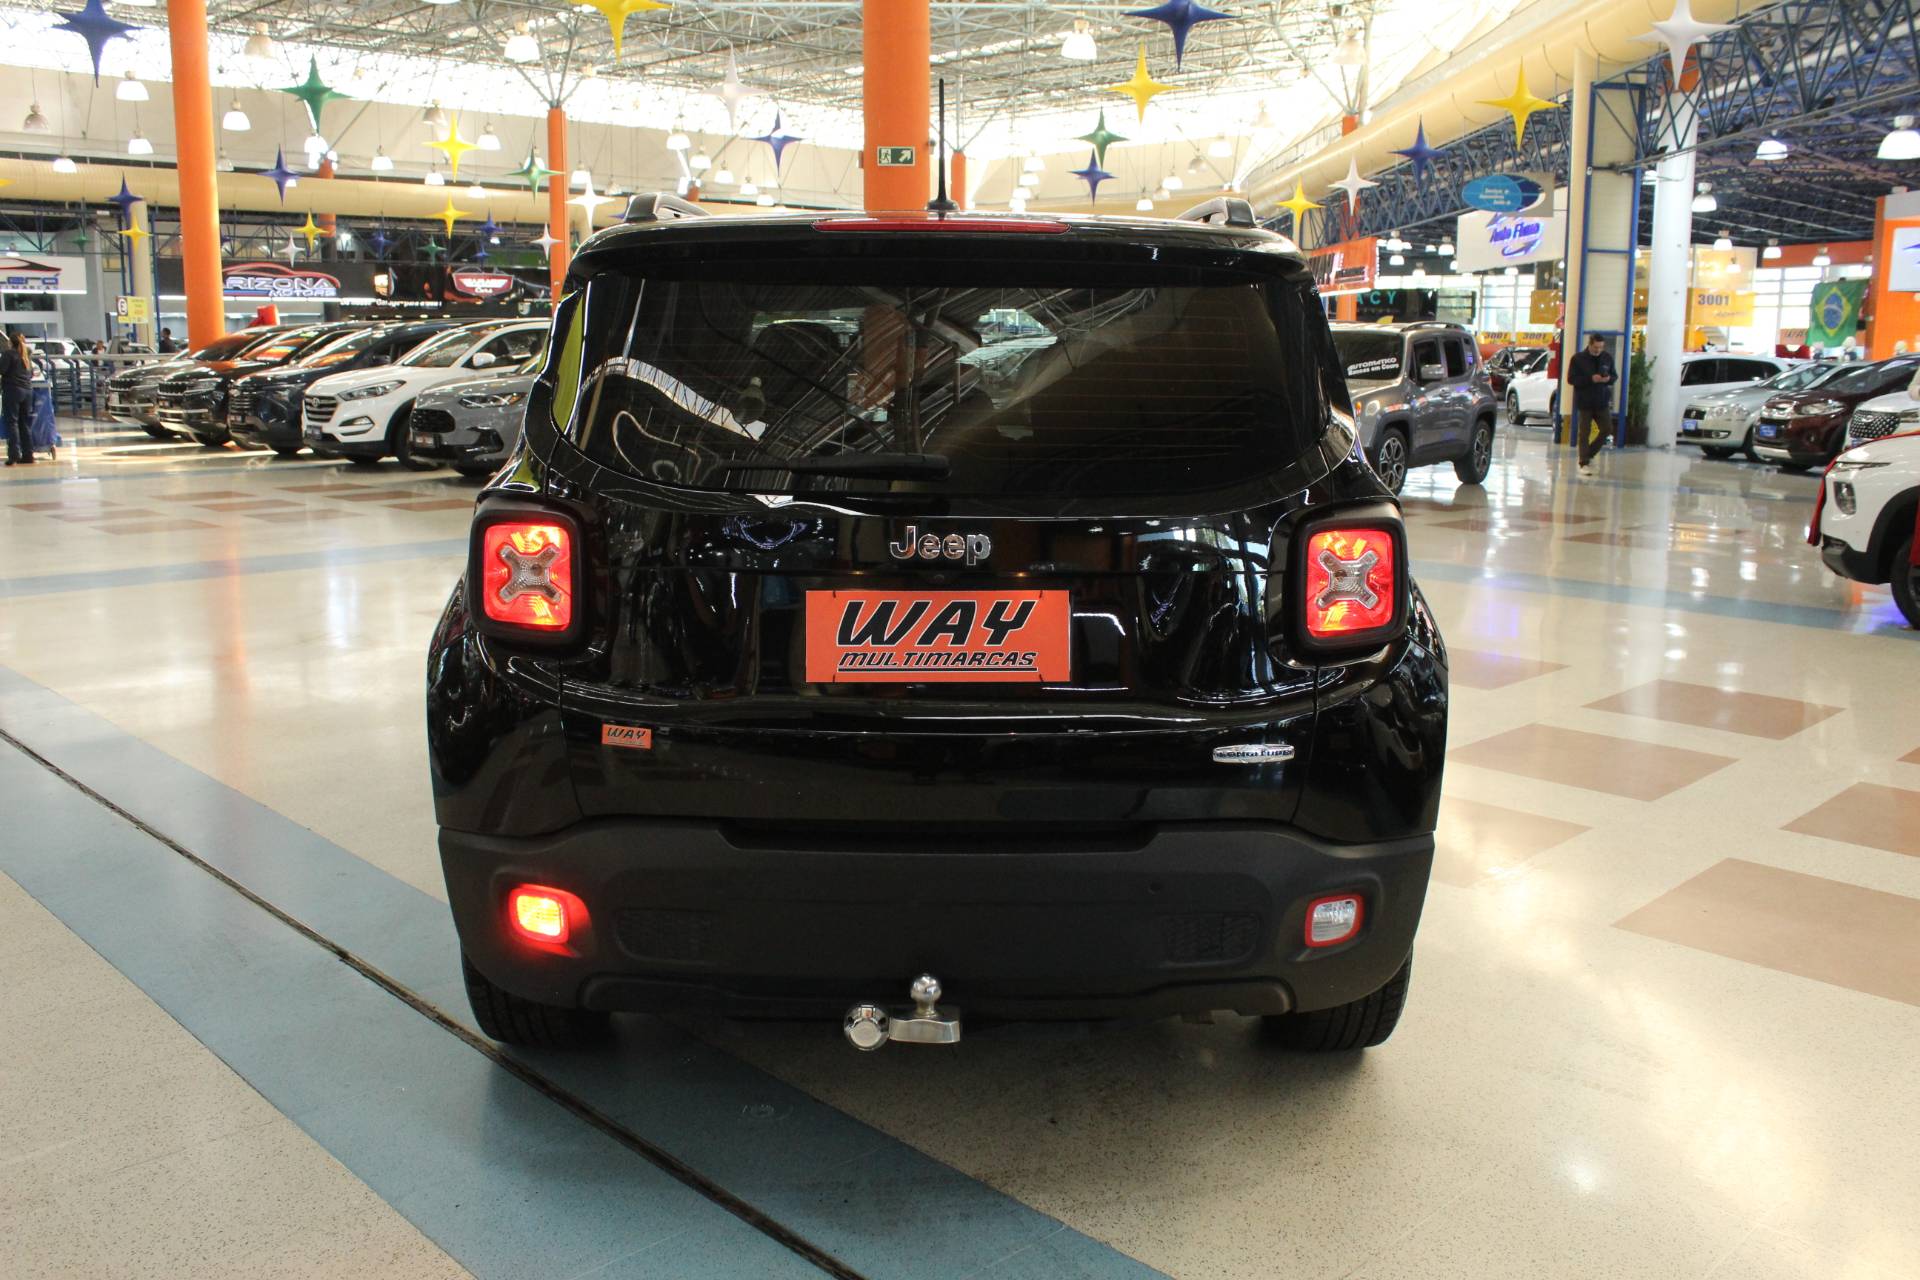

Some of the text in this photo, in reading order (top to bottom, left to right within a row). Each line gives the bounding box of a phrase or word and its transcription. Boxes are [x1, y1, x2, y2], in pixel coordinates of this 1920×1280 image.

[223, 276, 337, 290] RIZONA
[268, 288, 337, 297] MOTORS
[1697, 293, 1730, 306] 3001
[889, 525, 992, 566] Jeep
[836, 600, 1040, 647] WAY
[838, 651, 1038, 667] MULTIMARCAS
[607, 727, 647, 740] WAY
